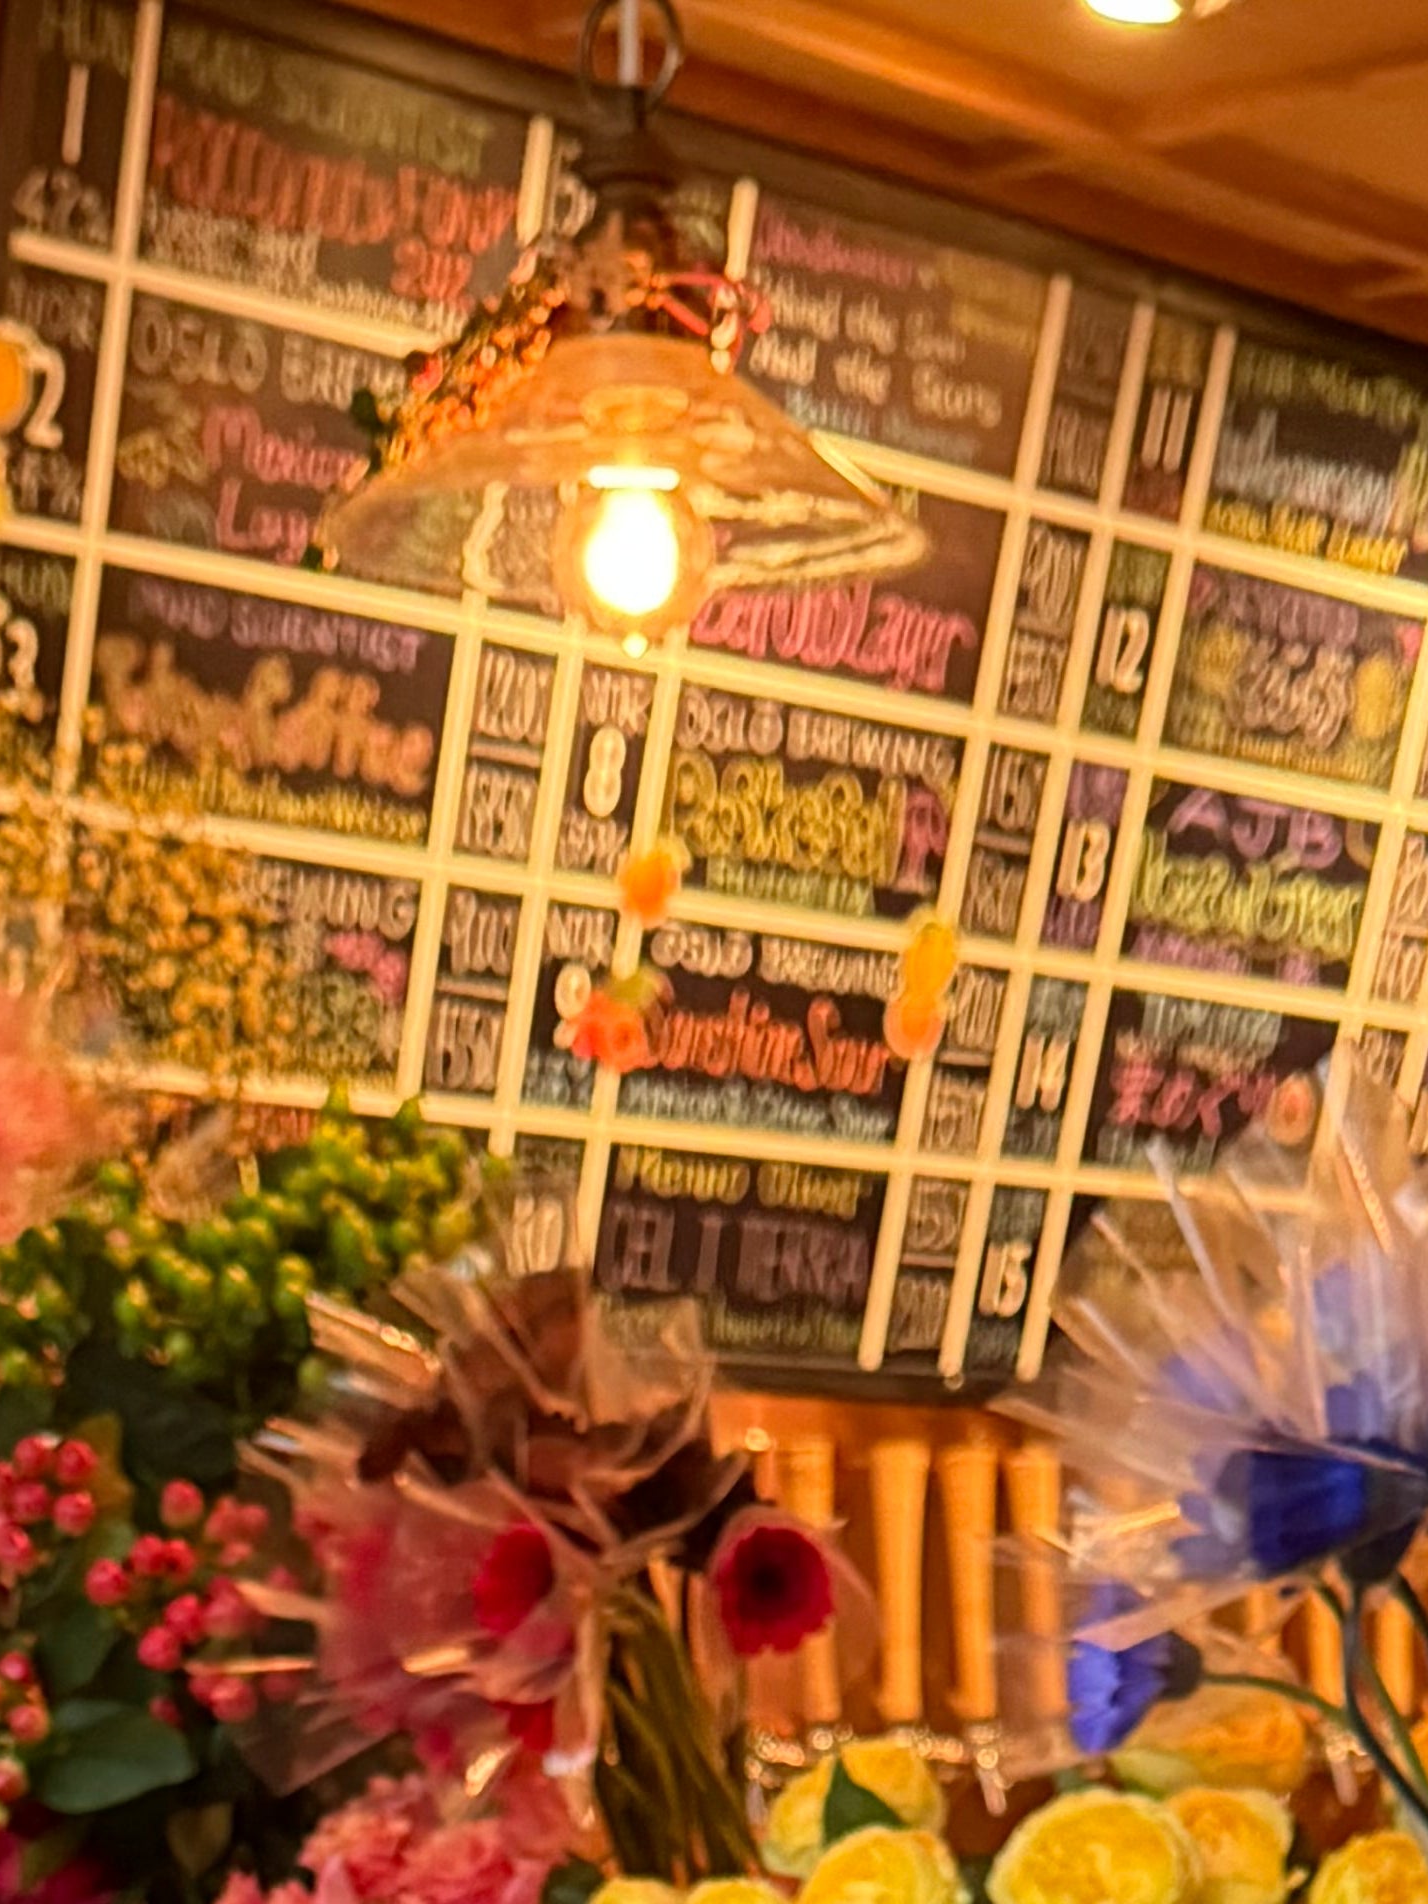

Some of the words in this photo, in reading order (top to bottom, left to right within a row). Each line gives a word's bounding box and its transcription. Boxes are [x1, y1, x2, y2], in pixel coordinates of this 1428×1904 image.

[1095, 602, 1151, 694] 12
[583, 725, 627, 818] 8
[1055, 818, 1112, 902] 13
[977, 1239, 1034, 1318] 15
